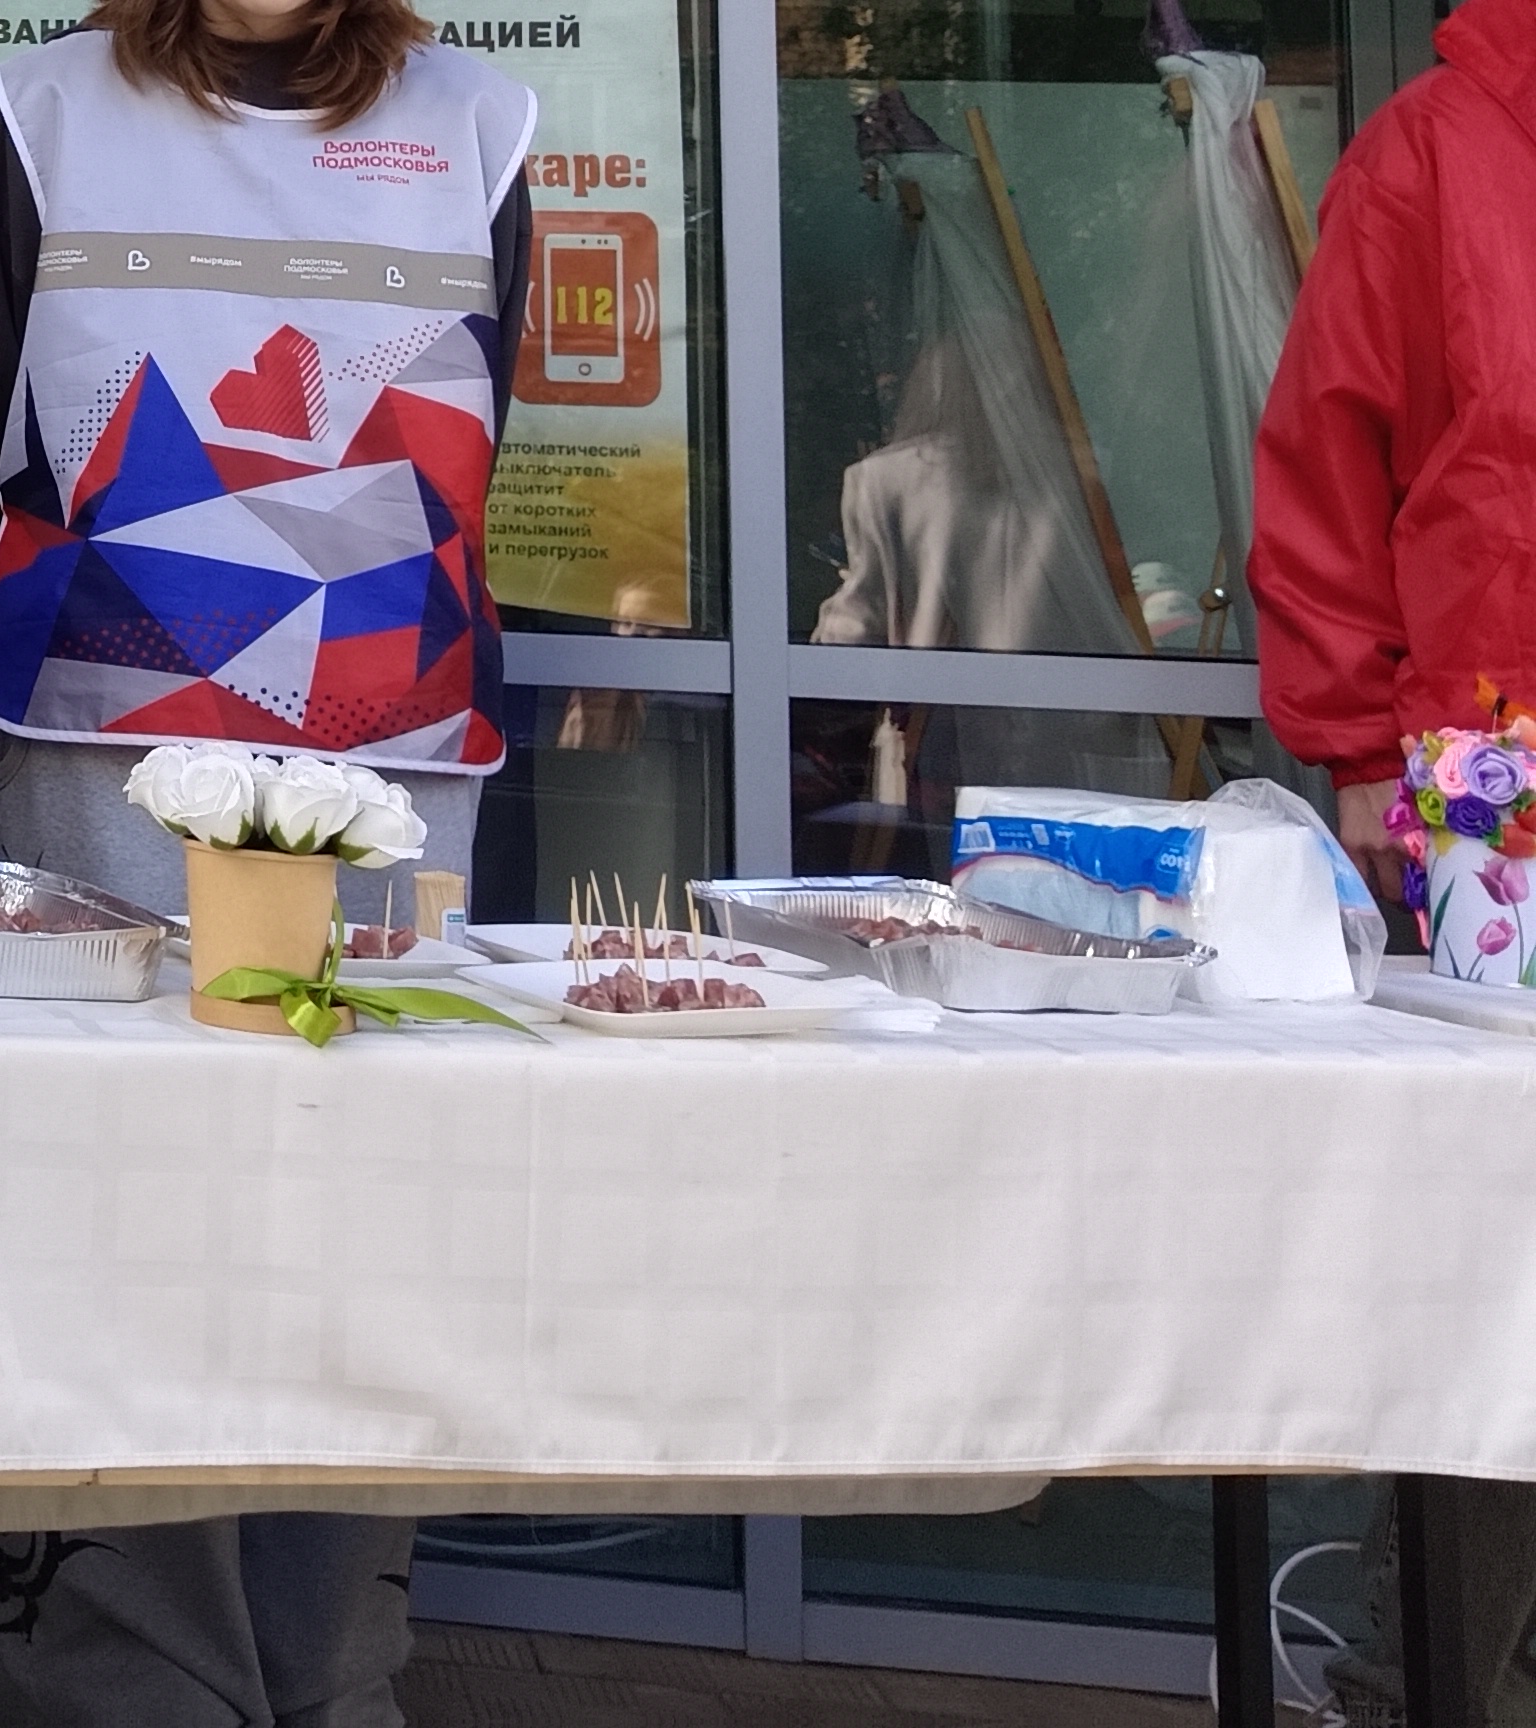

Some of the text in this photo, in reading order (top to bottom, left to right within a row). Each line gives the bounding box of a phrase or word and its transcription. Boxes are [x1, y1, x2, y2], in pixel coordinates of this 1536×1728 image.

[324, 140, 435, 157] ВОЛОНТЕРЫ
[312, 155, 449, 173] ПОДМОСКОВЬЯ
[556, 286, 613, 326] 112
[500, 442, 641, 458] втоматический
[488, 503, 597, 519] от коротких
[488, 522, 592, 538] замыканий
[488, 543, 609, 562] и перегрузок
